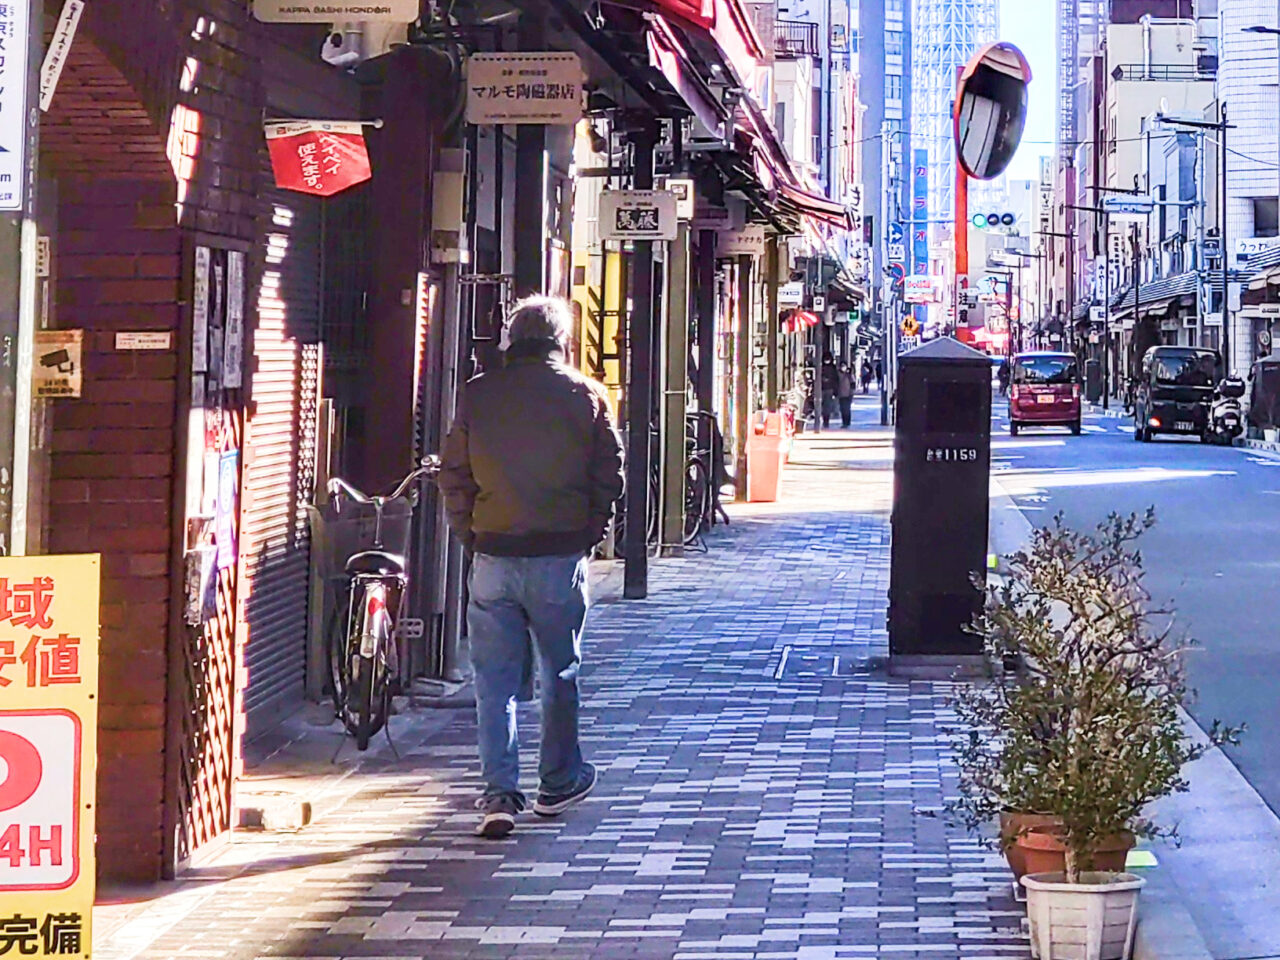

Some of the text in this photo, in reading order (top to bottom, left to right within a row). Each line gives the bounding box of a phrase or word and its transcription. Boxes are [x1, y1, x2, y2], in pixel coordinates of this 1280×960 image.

[472, 83, 575, 100] マルモ陶磁器店
[298, 142, 323, 190] 使えます。
[319, 134, 342, 175] ペイペイ
